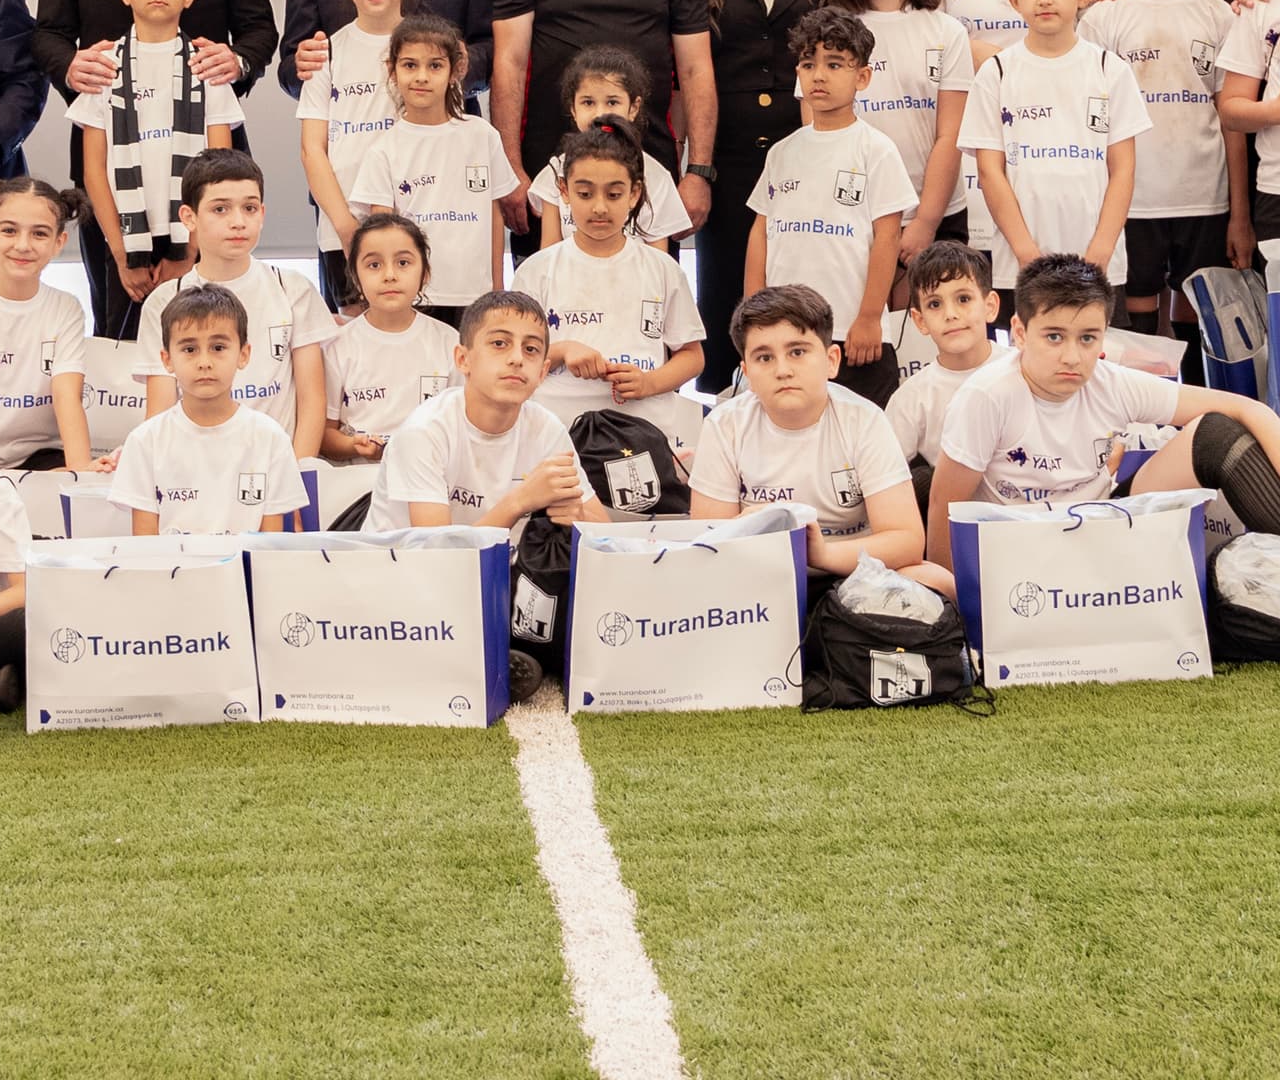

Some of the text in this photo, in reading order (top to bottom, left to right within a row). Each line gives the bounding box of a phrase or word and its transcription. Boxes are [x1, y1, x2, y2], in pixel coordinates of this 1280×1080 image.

[974, 19, 1029, 32] Turan
[1127, 49, 1161, 63] YAŞAT
[343, 83, 377, 96] YAŞAT
[1140, 89, 1214, 104] uranBan
[1017, 107, 1053, 121] YAŞAT
[343, 118, 395, 135] TuranB
[416, 210, 479, 224] TuranBank
[776, 219, 855, 238] TuranBank
[564, 312, 604, 326] YAŞAT
[230, 380, 282, 400] nBank
[352, 387, 387, 402] YAŞAT
[167, 488, 200, 503] YAŞAT
[450, 485, 485, 509] AŞAT
[751, 487, 795, 503] YAŞAT
[1047, 579, 1184, 609] TuranBank
[635, 602, 769, 638] TuranBank
[316, 620, 455, 643] TuranBank
[87, 631, 231, 657] TuranBank
